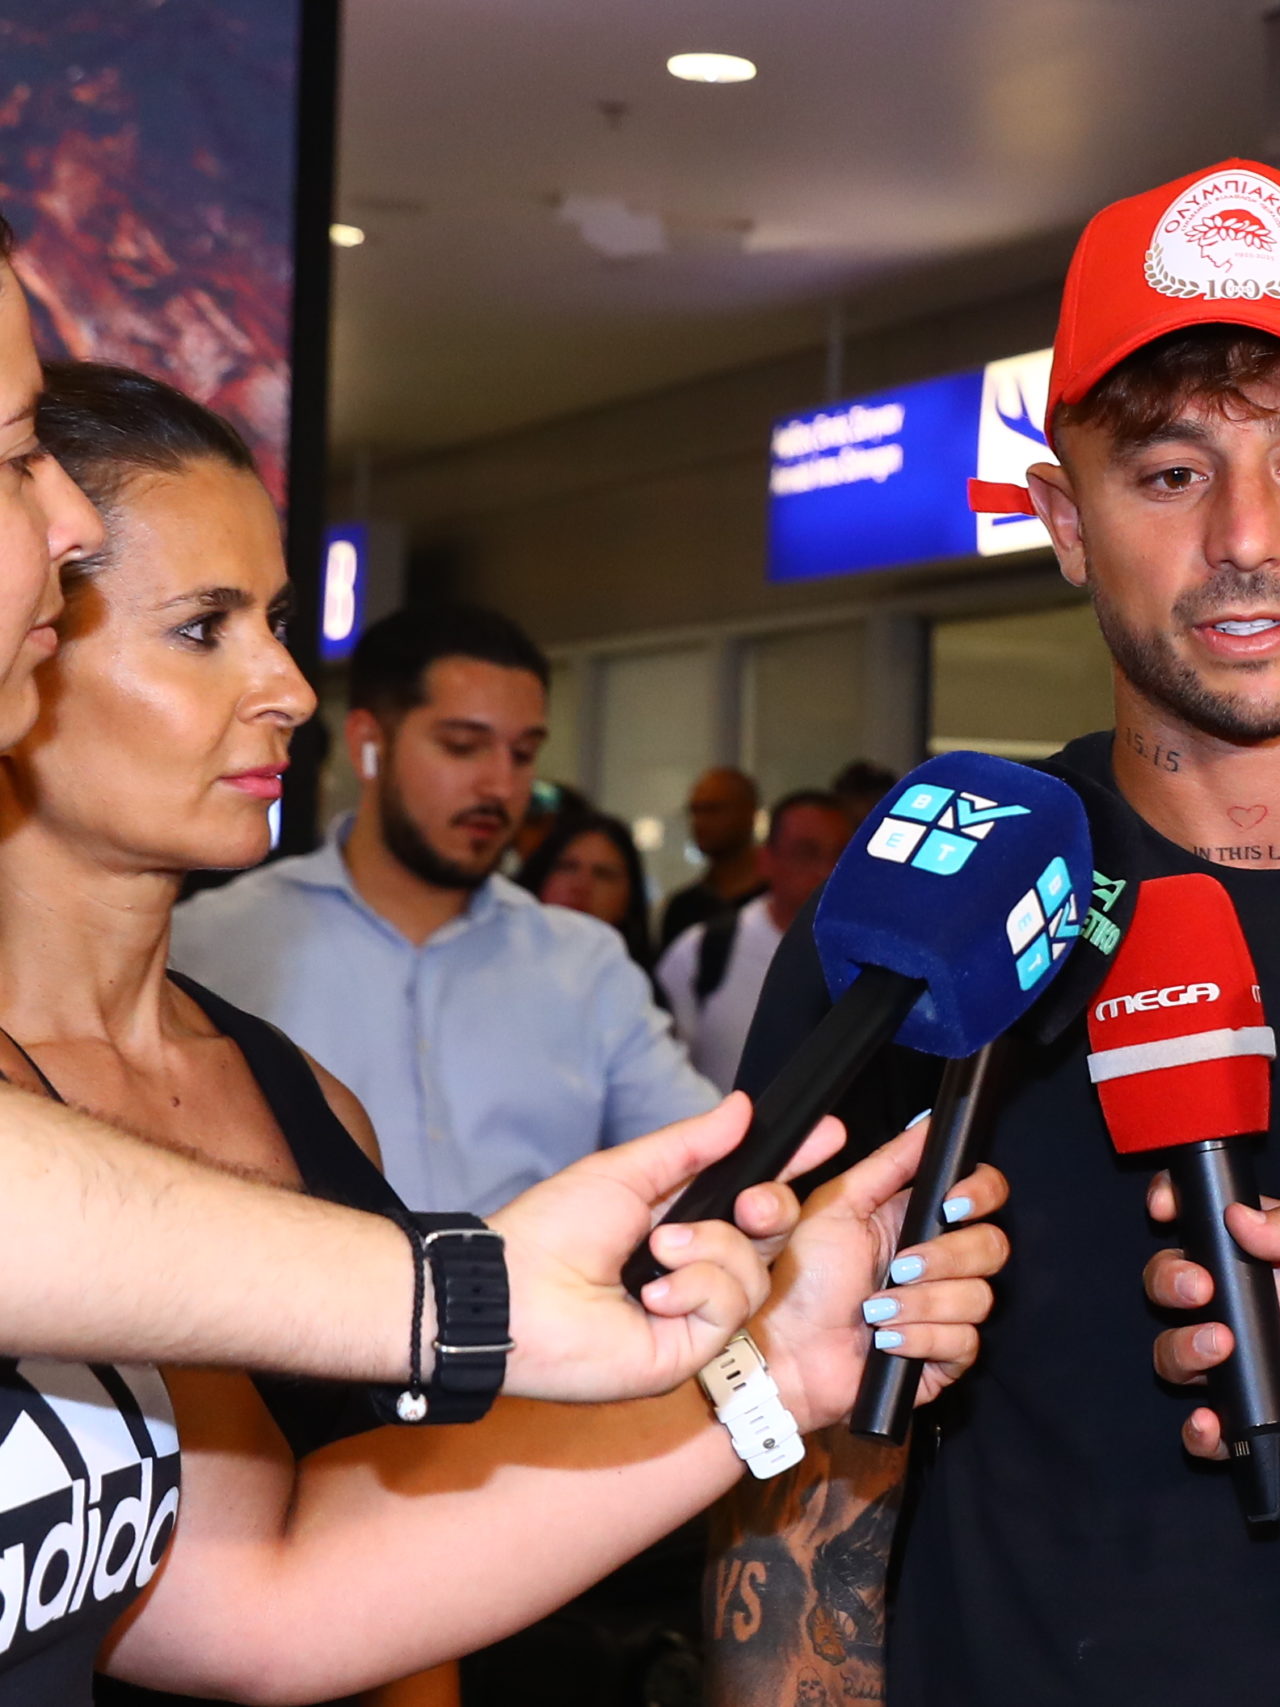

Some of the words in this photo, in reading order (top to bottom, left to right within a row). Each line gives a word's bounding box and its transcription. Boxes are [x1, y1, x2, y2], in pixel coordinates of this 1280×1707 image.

[1207, 278, 1260, 299] 100
[1216, 845, 1262, 862] THIS
[1095, 982, 1220, 1022] MEGA
